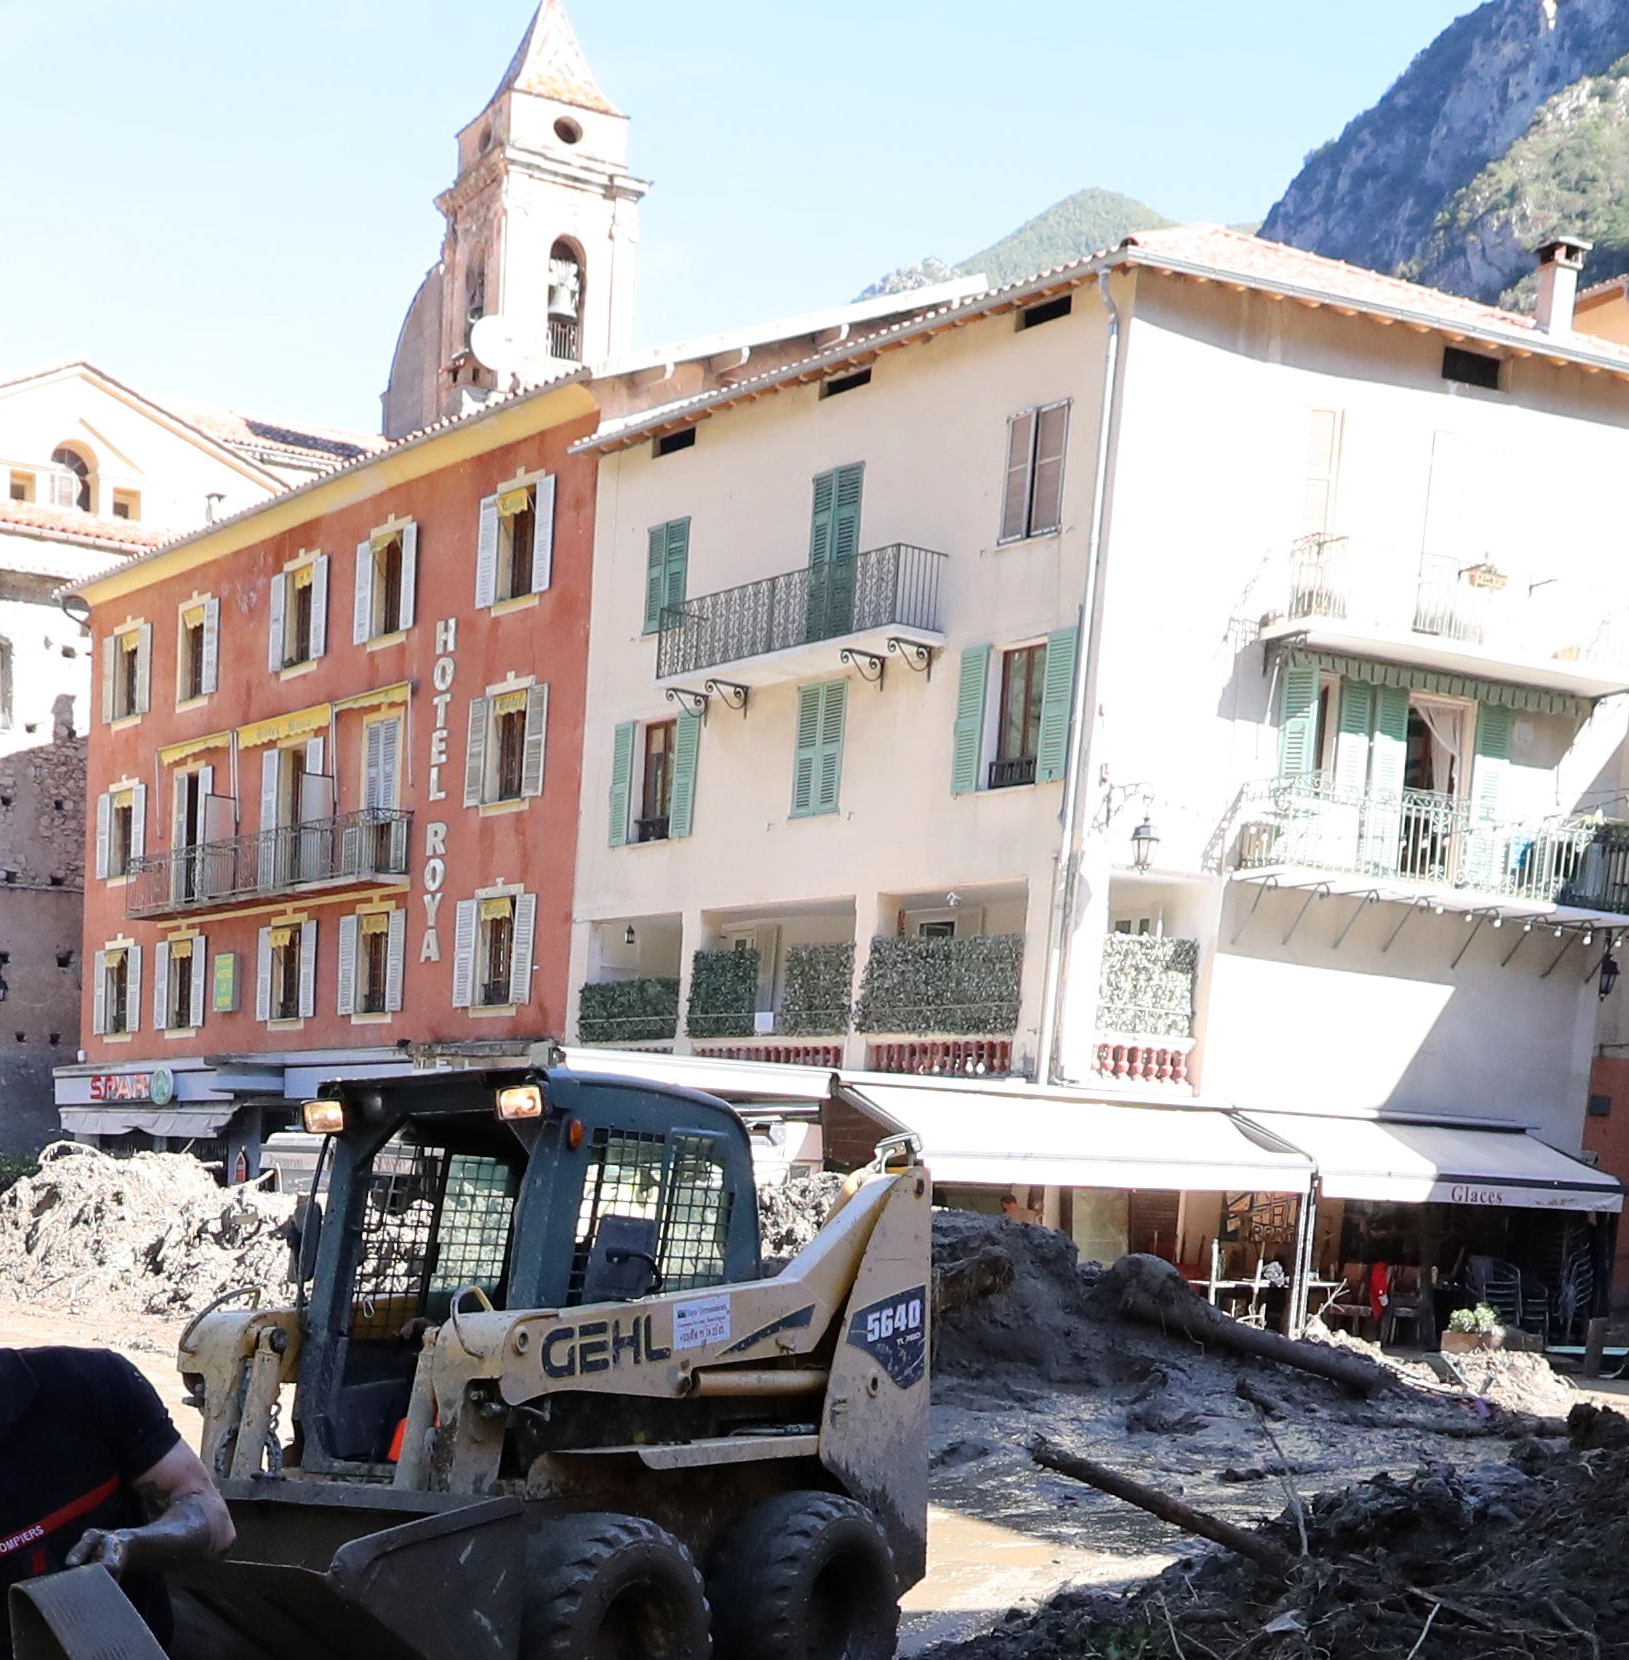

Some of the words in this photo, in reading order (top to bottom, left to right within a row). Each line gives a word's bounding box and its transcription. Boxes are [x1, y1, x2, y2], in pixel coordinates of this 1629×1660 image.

[429, 618, 458, 802] HOTEL
[420, 822, 448, 963] ROYA
[90, 1074, 150, 1099] SPAR
[1452, 1185, 1502, 1204] Glaces
[541, 1314, 672, 1378] GEHL
[867, 1299, 921, 1343] 5640
